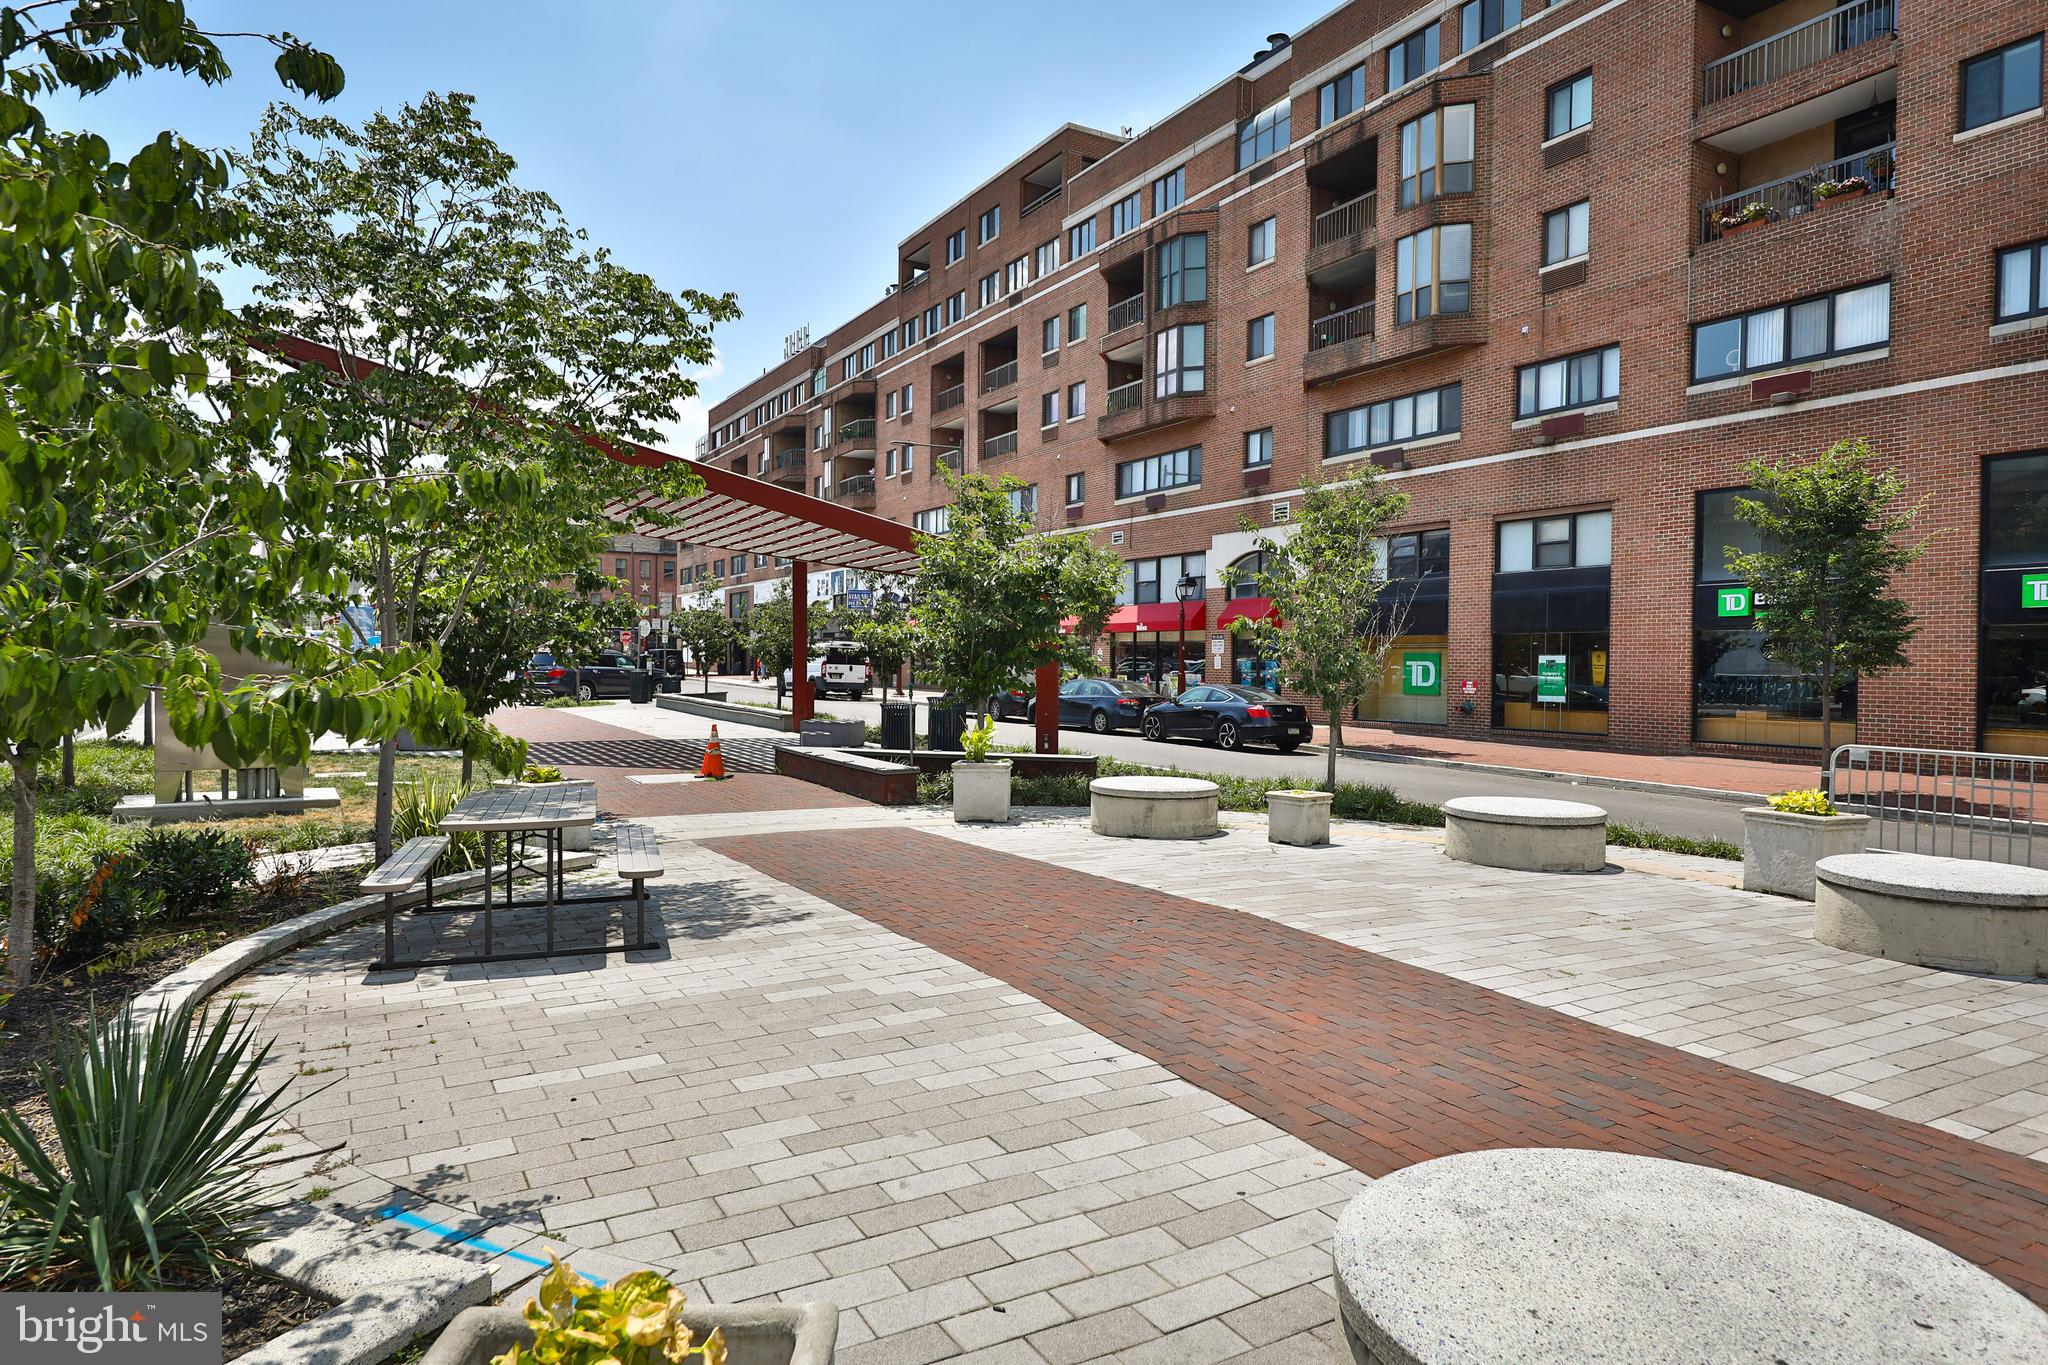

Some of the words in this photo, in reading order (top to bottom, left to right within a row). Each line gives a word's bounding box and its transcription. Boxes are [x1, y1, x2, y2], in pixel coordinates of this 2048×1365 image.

[848, 593, 873, 601] AVAILABE
[1721, 593, 1746, 611] TD
[1406, 660, 1436, 687] TD
